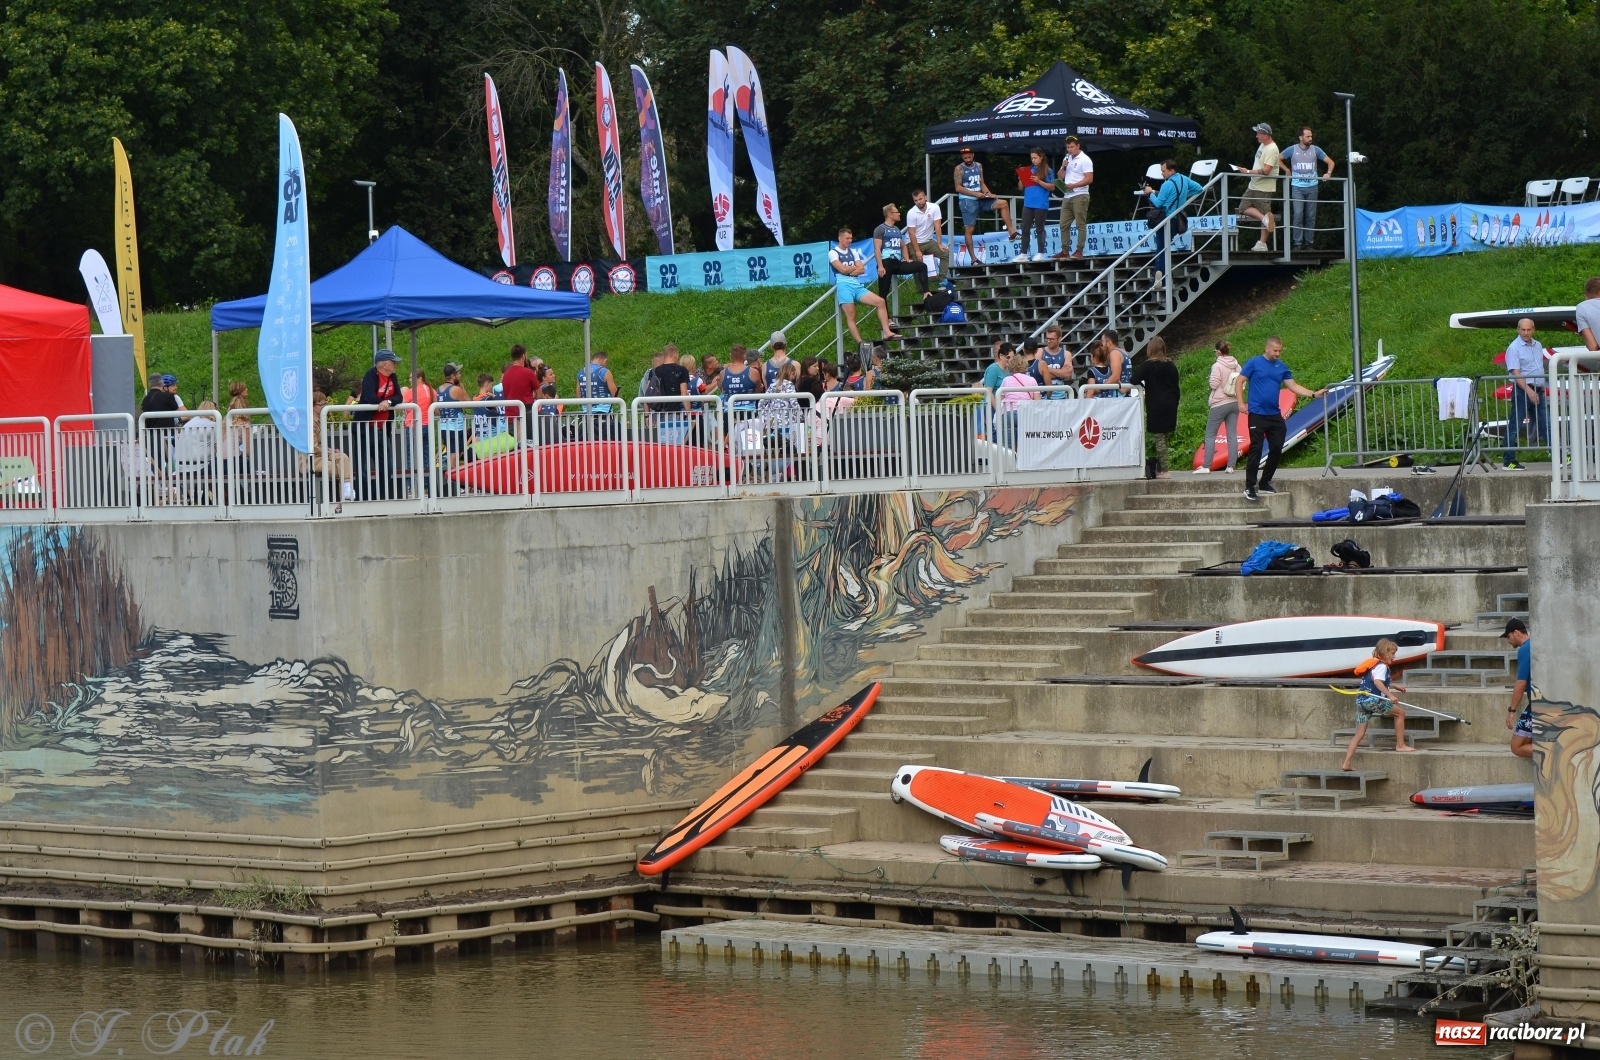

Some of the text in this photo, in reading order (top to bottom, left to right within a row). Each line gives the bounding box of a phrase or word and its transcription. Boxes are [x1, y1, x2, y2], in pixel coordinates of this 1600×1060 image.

[1102, 127, 1139, 136] KONFERANSJER
[1143, 128, 1150, 136] DJ
[1366, 236, 1383, 244] Aqua
[1025, 427, 1073, 441] www.zwsup.pl
[1101, 431, 1117, 441] SUP
